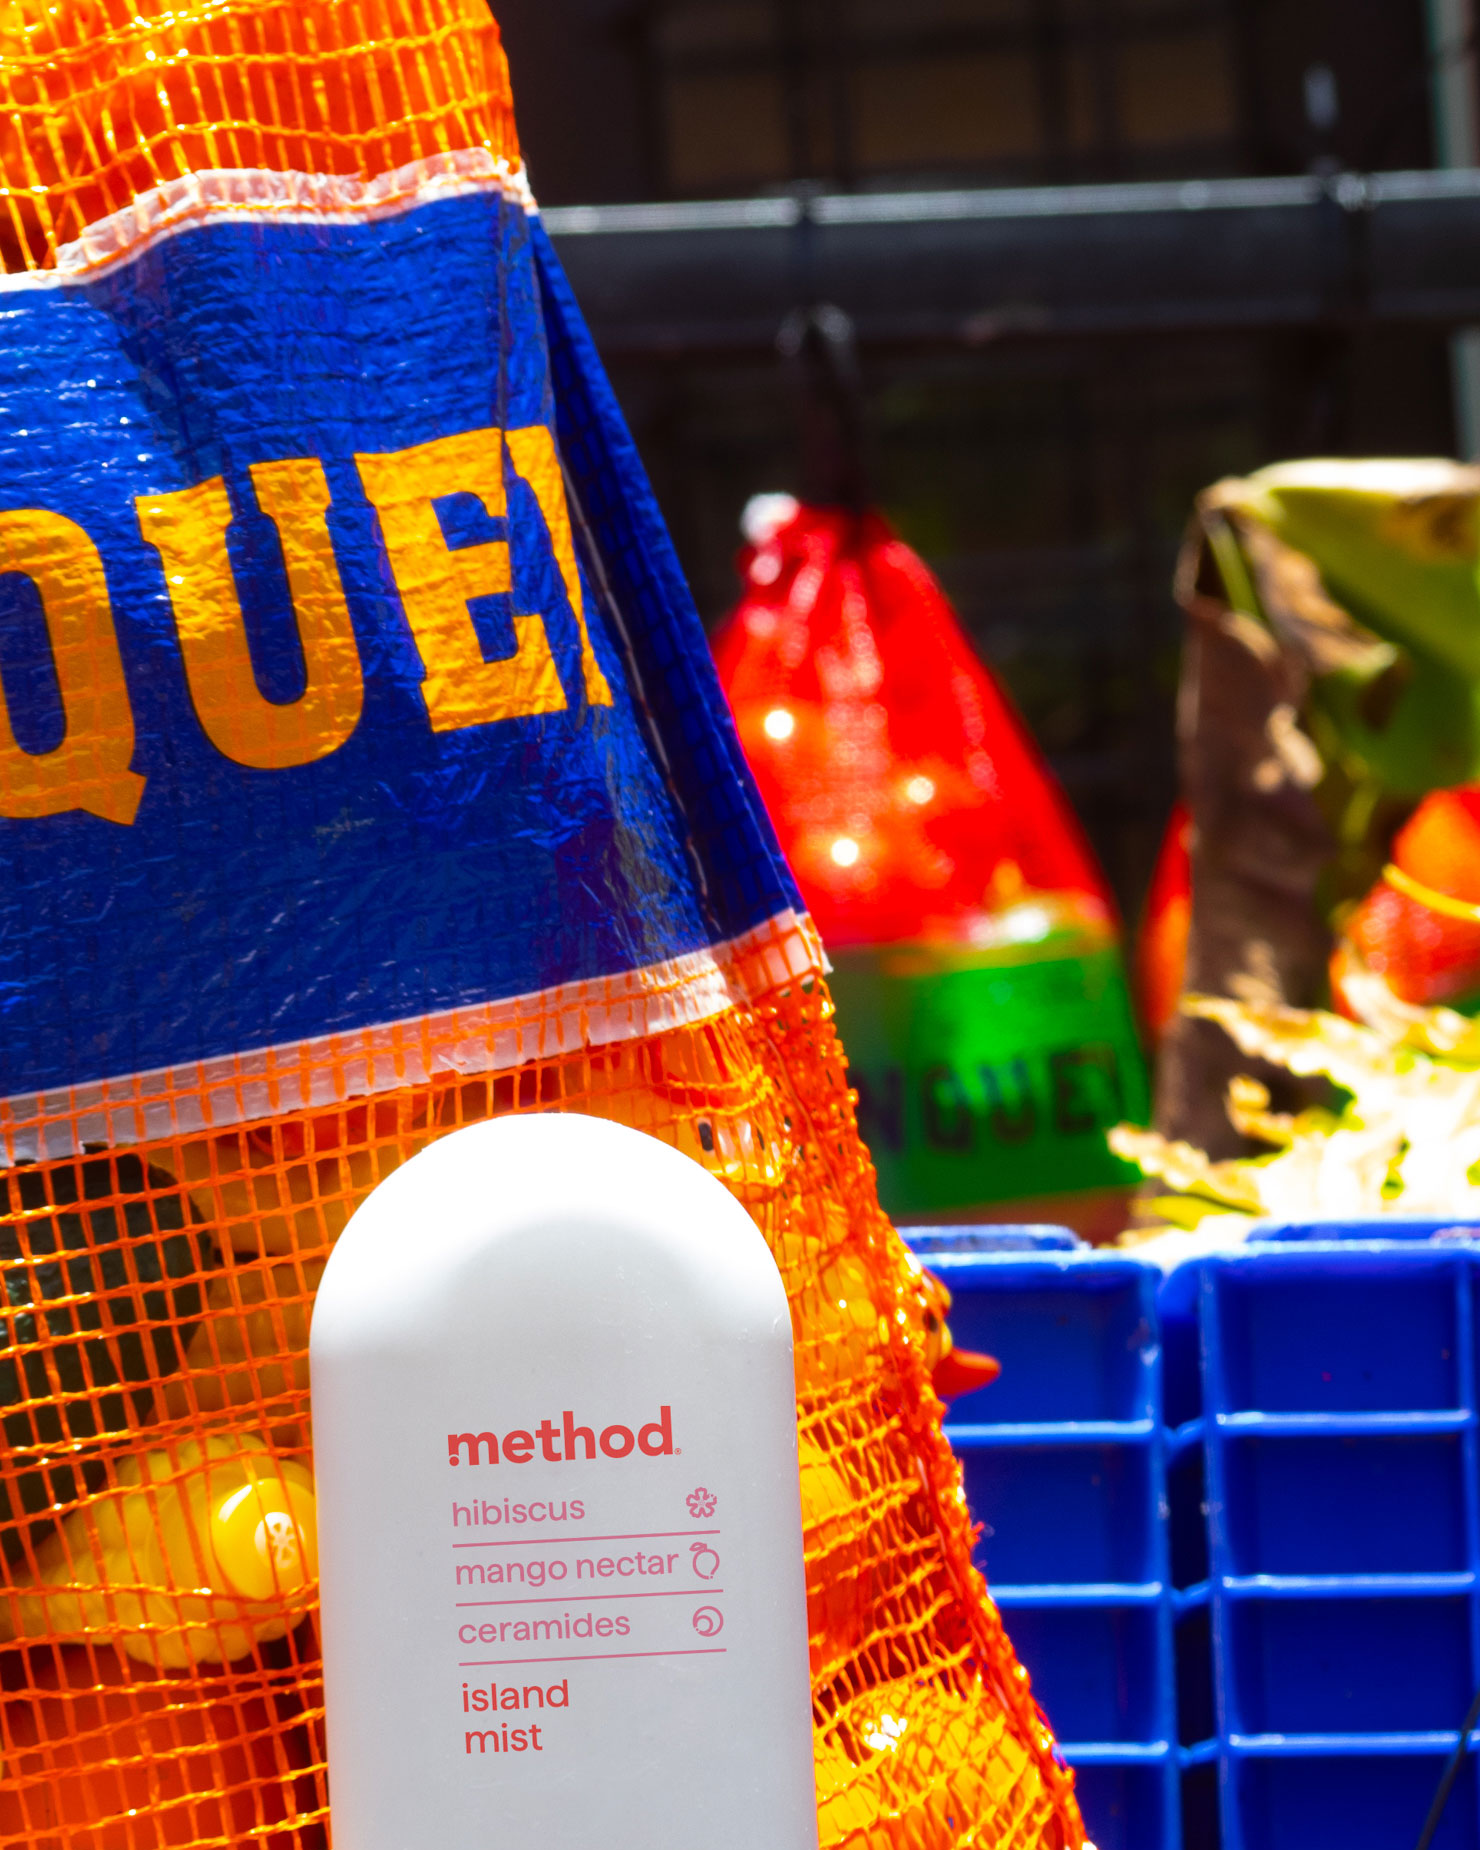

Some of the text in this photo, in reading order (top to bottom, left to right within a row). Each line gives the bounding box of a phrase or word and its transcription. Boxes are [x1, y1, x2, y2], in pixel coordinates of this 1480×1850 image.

[453, 1498, 585, 1526] hibiscus
[456, 1552, 679, 1587] mango nectar
[459, 1613, 630, 1644] ceramides
[462, 1679, 568, 1712] island
[465, 1723, 542, 1754] mist
